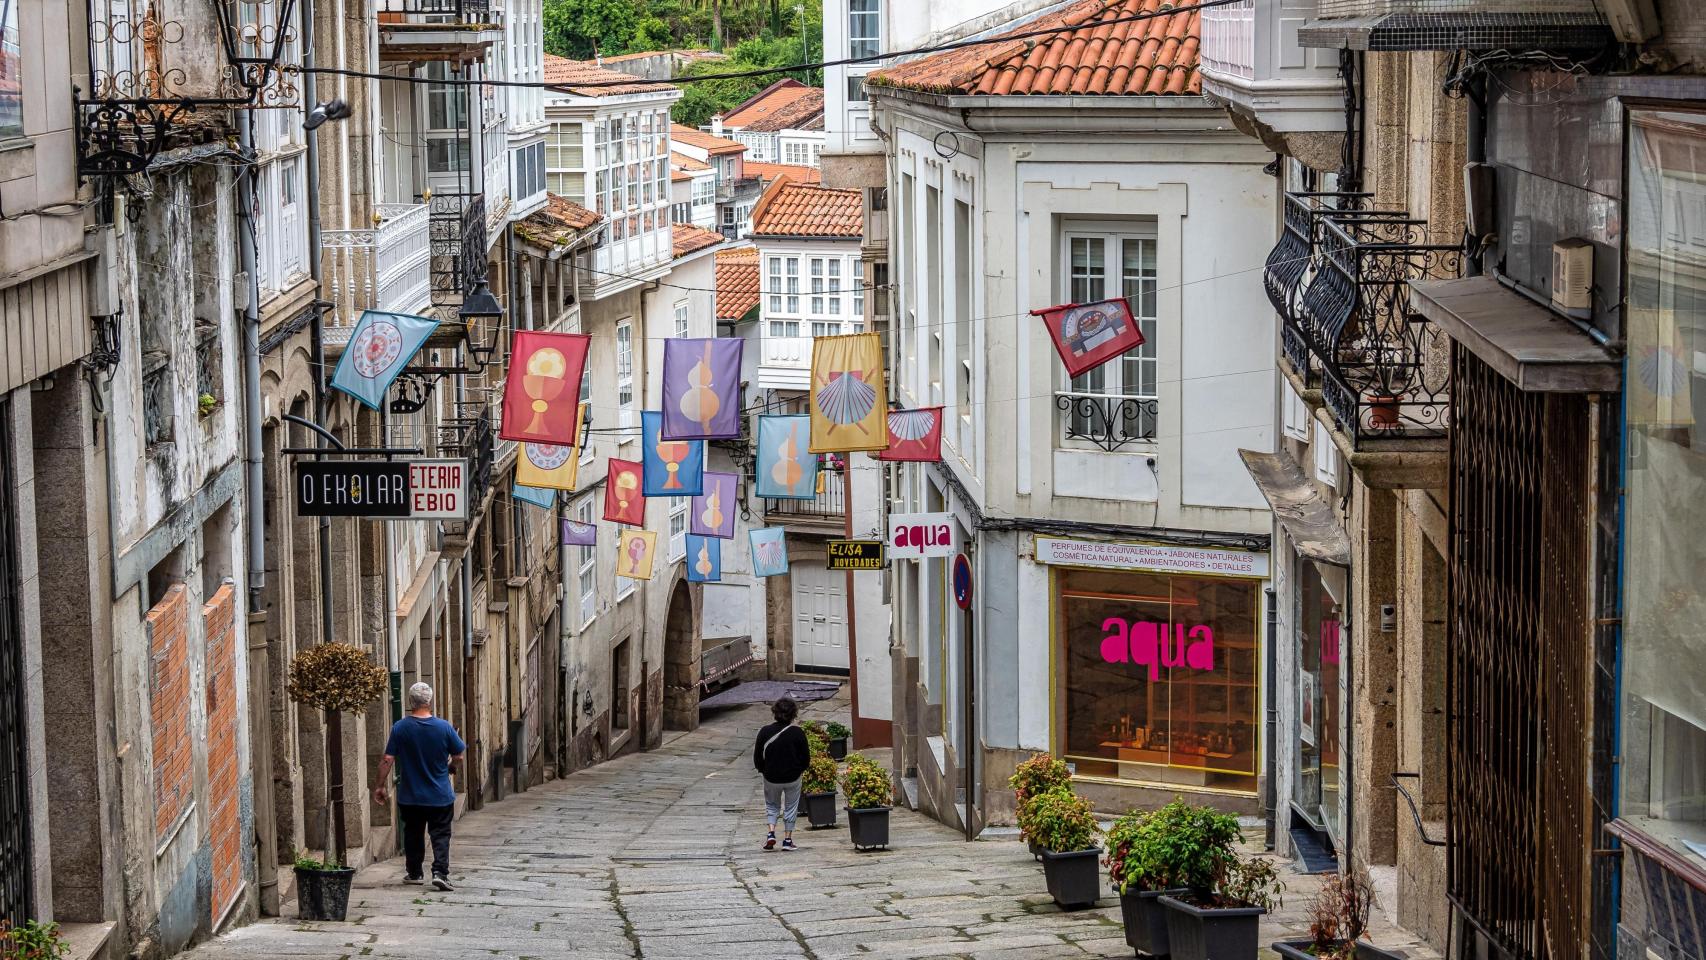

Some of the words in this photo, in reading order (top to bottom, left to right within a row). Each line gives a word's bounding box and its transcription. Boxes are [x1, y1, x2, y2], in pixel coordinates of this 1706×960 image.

[303, 474, 314, 504] O
[323, 474, 404, 504] EKOLAR
[411, 493, 456, 511] EBIO
[894, 524, 951, 554] aqua
[830, 544, 862, 556] ELISA
[1051, 542, 1093, 552] PERFUMES
[1094, 545, 1105, 553] DE
[1107, 546, 1162, 556] EQUIVALENCIA
[1168, 550, 1205, 560] JABONES
[1206, 552, 1254, 563] NATURALES
[834, 558, 880, 567] NOVEDADES
[1098, 554, 1134, 564] NATURAL
[1139, 557, 1206, 568] AMBIENTADORES
[1212, 562, 1252, 572] DETALLES
[1100, 616, 1214, 682] aqua
